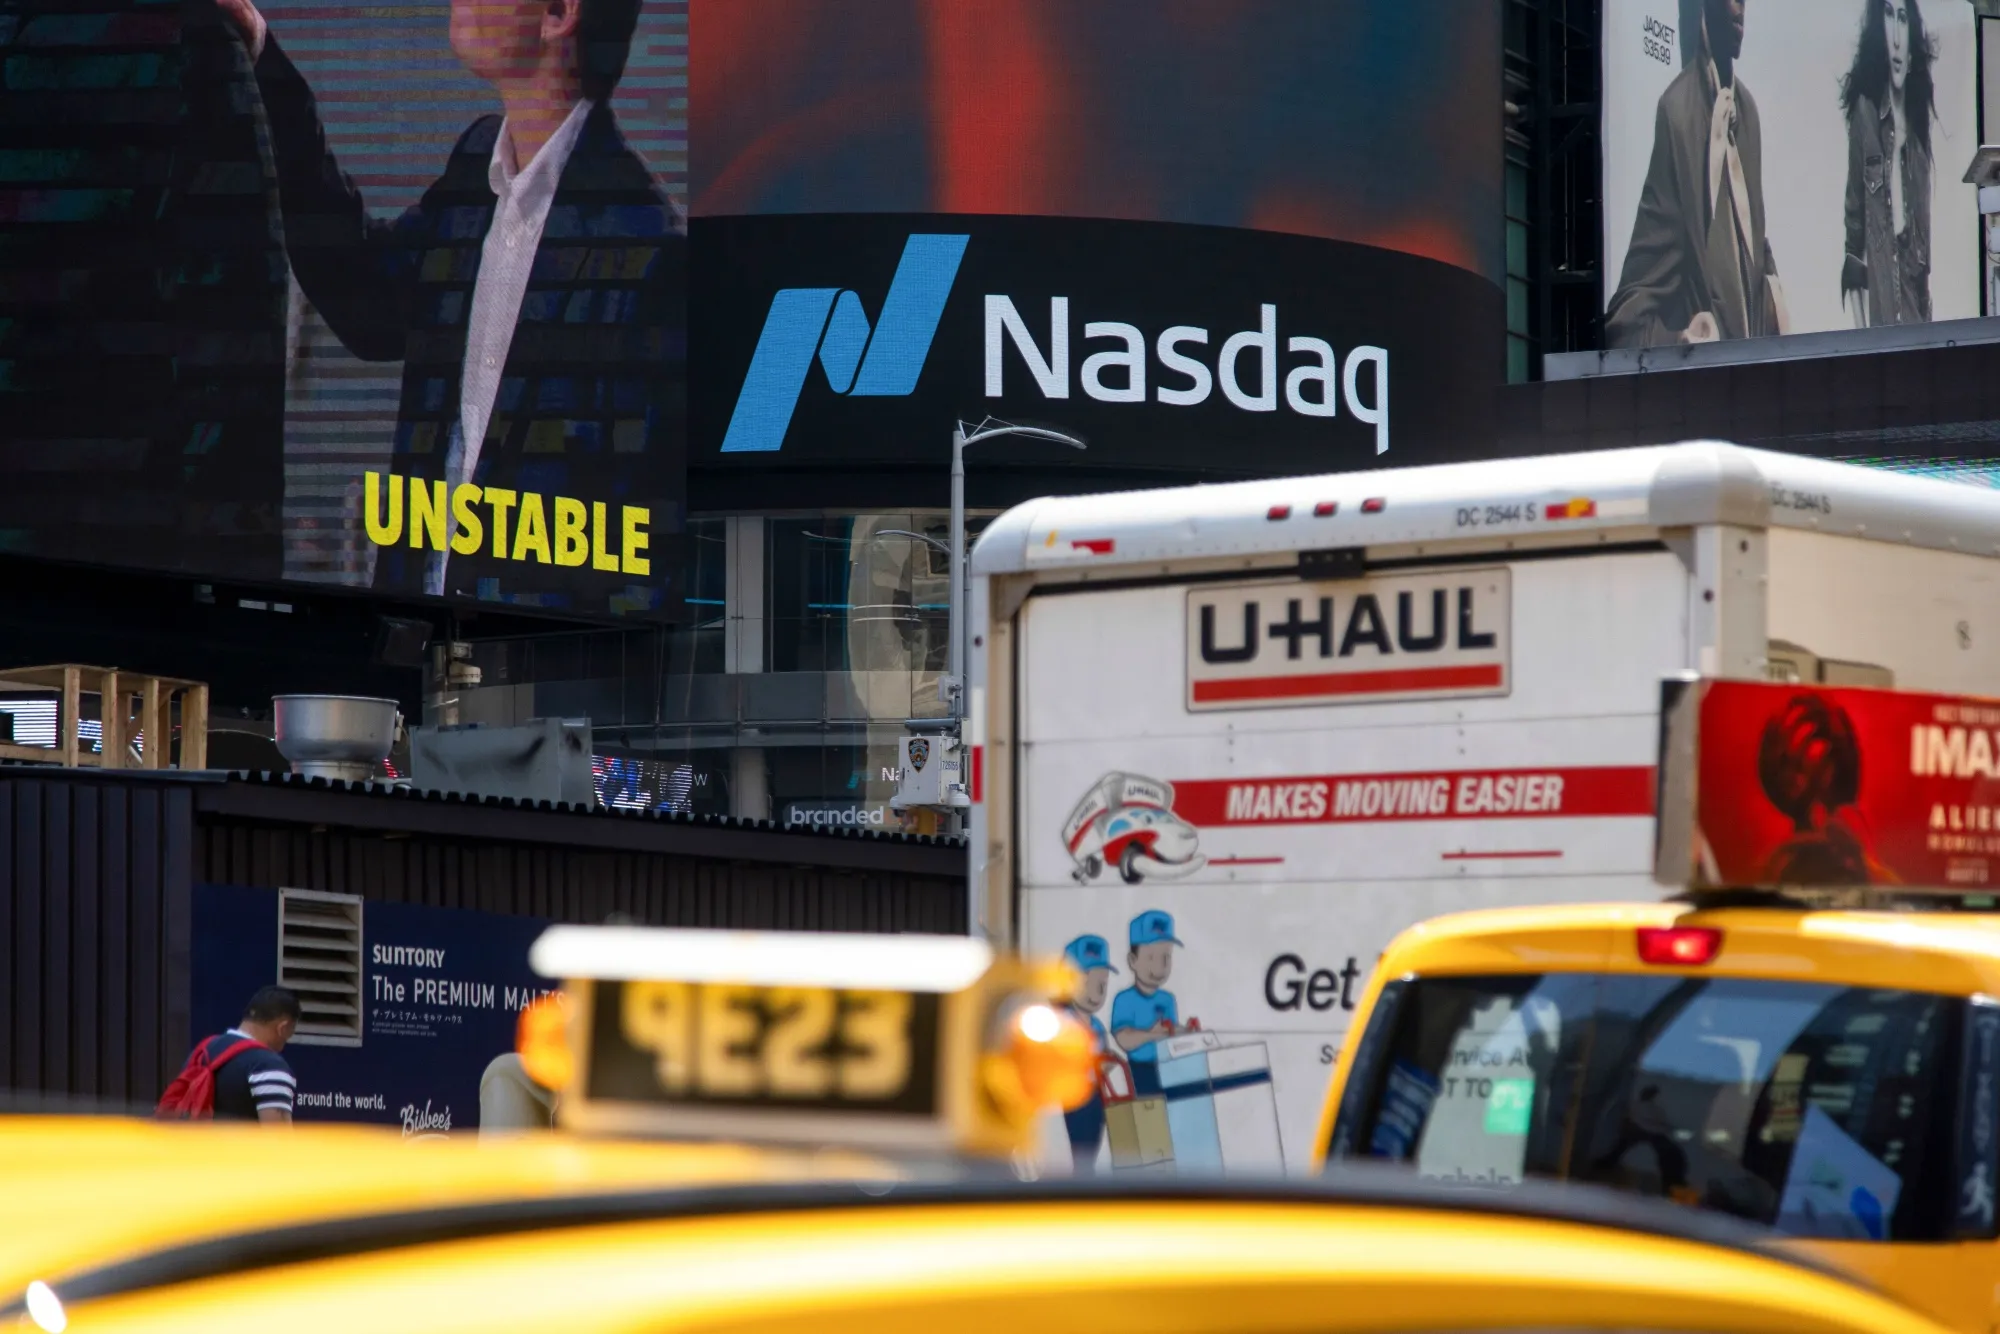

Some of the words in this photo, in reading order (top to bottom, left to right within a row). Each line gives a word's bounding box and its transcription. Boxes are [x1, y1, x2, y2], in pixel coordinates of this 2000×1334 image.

[1643, 14, 1675, 45] JACKET
[1643, 36, 1671, 65] $35.99
[984, 294, 1389, 455] Nasdaq
[364, 470, 650, 576] UNSTABLE
[1456, 507, 1481, 527] DC
[791, 805, 884, 826] branded
[1226, 782, 1328, 821] MAKES
[1333, 776, 1452, 817] MOVING
[1455, 774, 1566, 813] EASIER
[372, 973, 406, 1003] The
[413, 977, 496, 1010] PREMIUM
[1264, 952, 1361, 1012] Get
[297, 1092, 333, 1108] around
[335, 1093, 352, 1109] the
[354, 1094, 387, 1111] world.
[400, 1098, 452, 1138] Bisbee's
